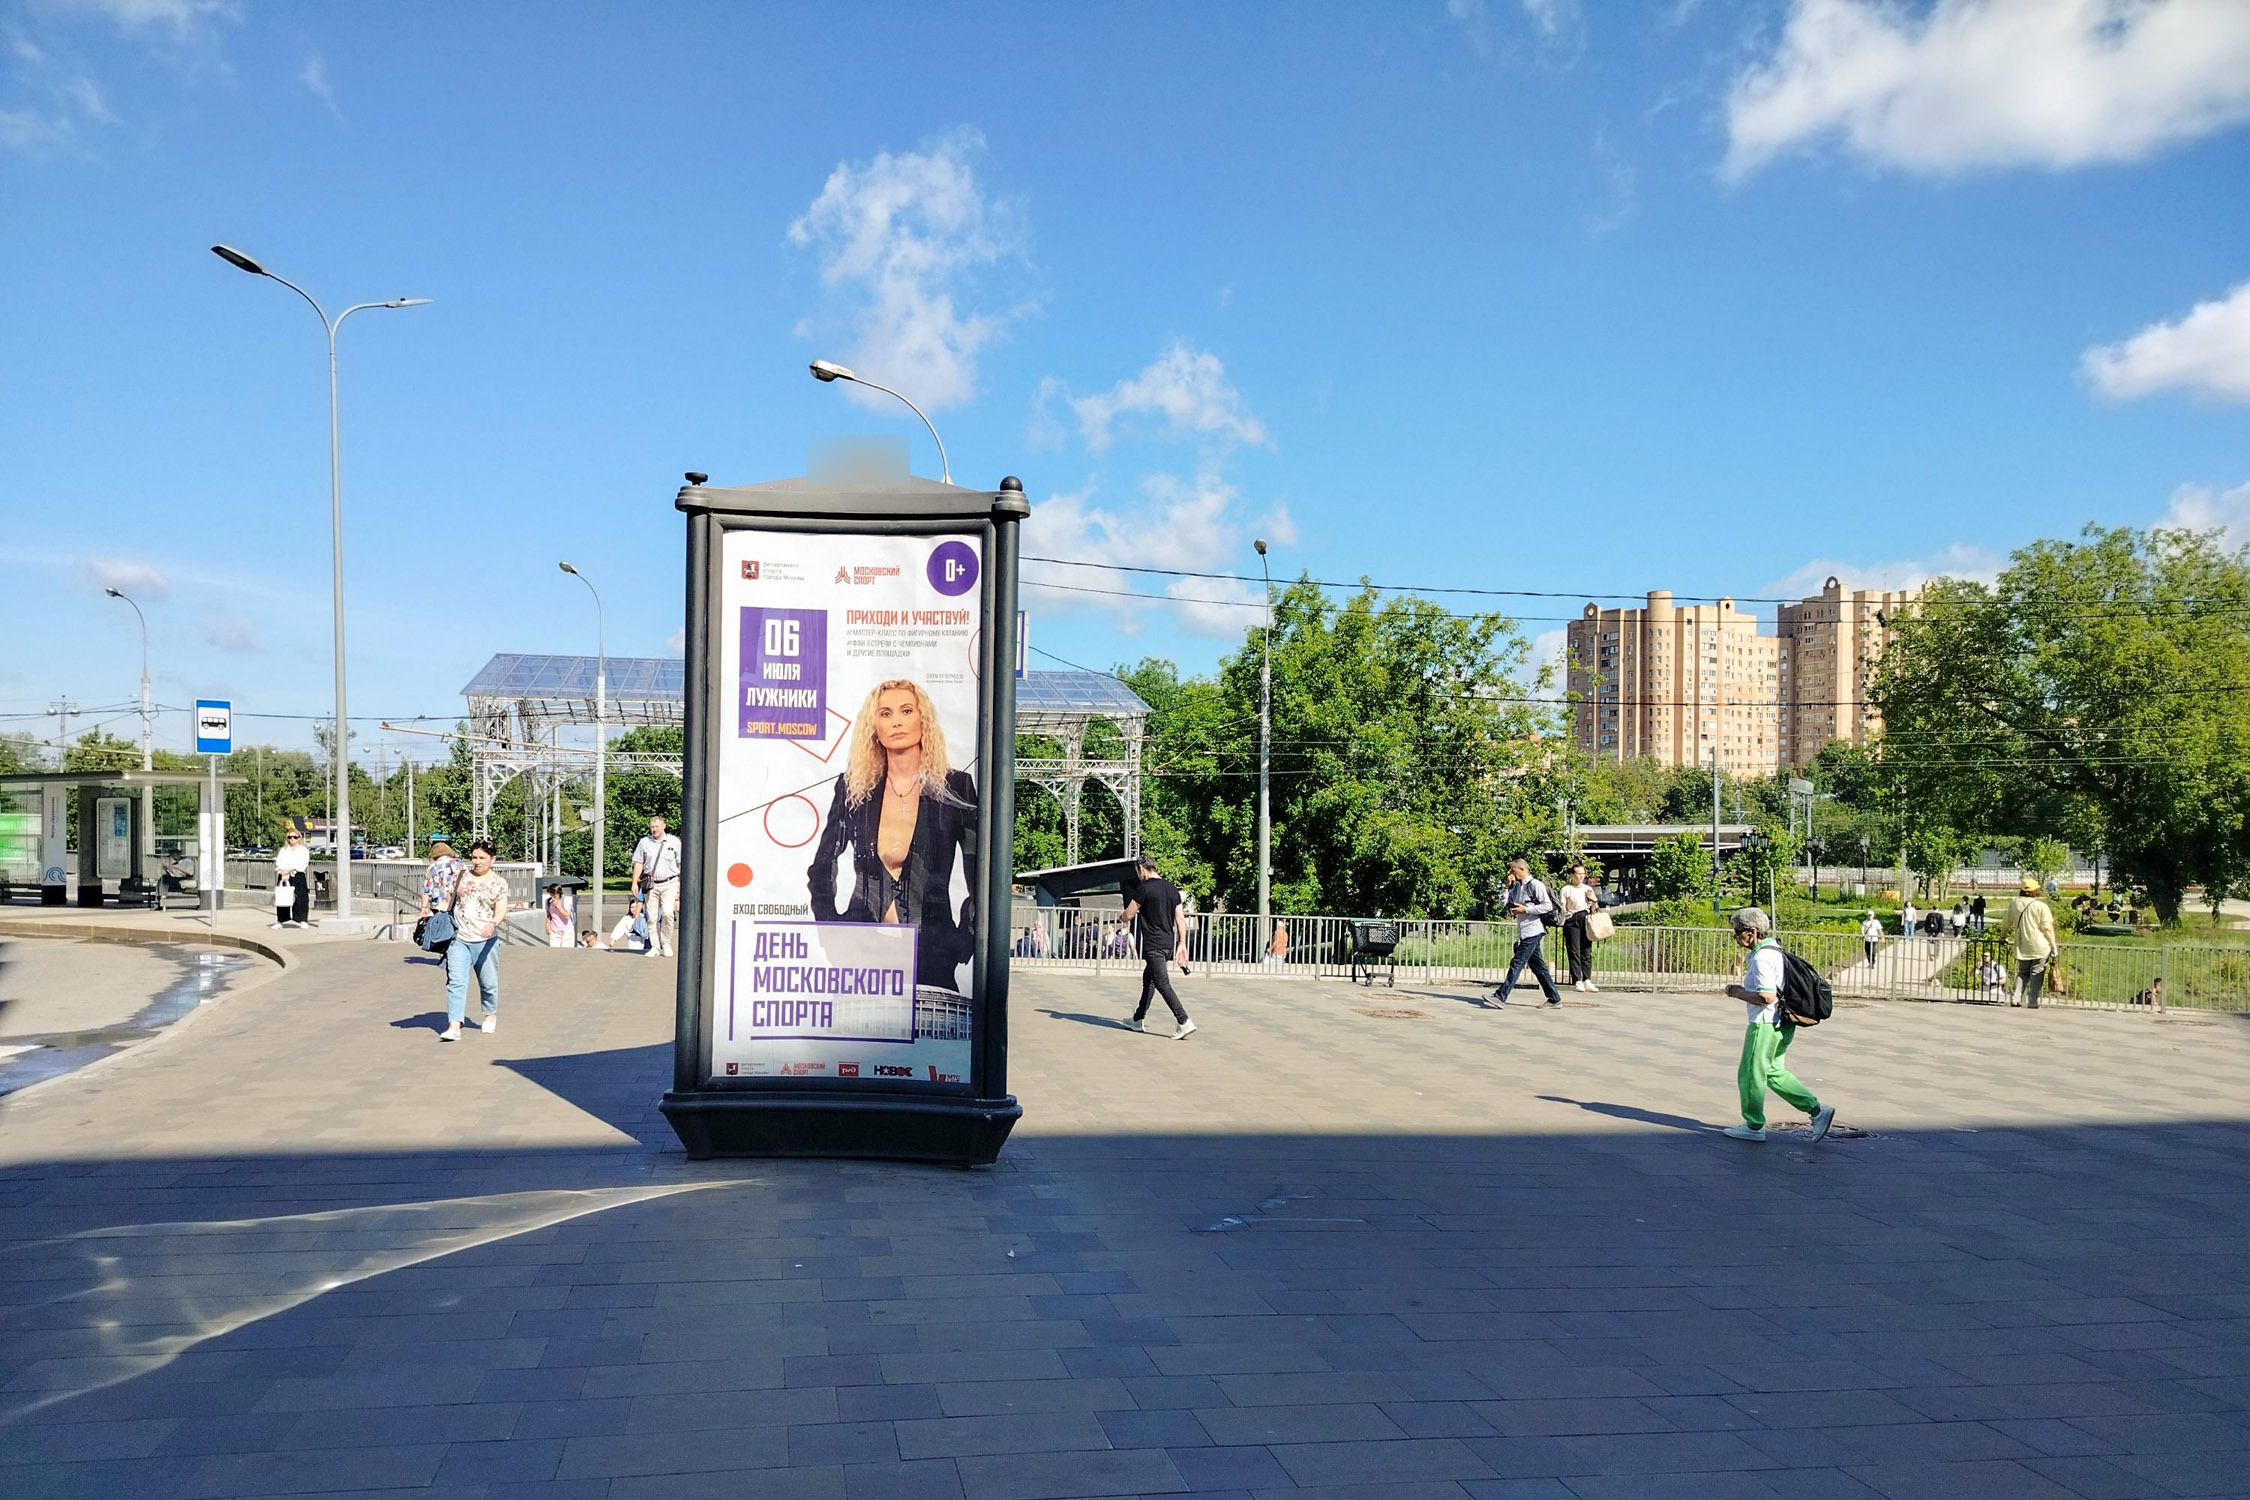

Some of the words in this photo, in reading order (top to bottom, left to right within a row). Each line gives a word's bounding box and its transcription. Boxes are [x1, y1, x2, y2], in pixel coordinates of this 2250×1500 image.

[853, 565, 900, 576] МОСКОВСКИЙ
[945, 559, 966, 582] 0+
[853, 576, 876, 585] СПОРТ
[846, 610, 898, 627] ПРИХОДИ
[901, 610, 909, 625] И
[912, 608, 970, 626] УЧАСТВУЙ!
[765, 619, 800, 656] 06
[907, 630, 941, 638] ФИГУРНОМУ
[941, 629, 969, 637] КАТАНИЮ
[867, 640, 892, 648] ВСТРЕЧИ
[893, 640, 898, 648] С
[898, 640, 937, 648] ЧЕМПИОНАМИ
[876, 650, 910, 658] ПЛОЩАДКИ
[763, 662, 800, 681] ИЮЛЯ
[745, 687, 817, 709] ЛУЖНИКИ
[746, 721, 817, 736] SPORT.MOSCOW
[733, 903, 756, 916] ВХОД
[758, 903, 809, 917] СВОБОДНЫЙ
[753, 932, 808, 962] ДЕНЬ
[753, 966, 904, 996] МОСКОВСКОГО
[752, 1000, 833, 1028] СПОРТА
